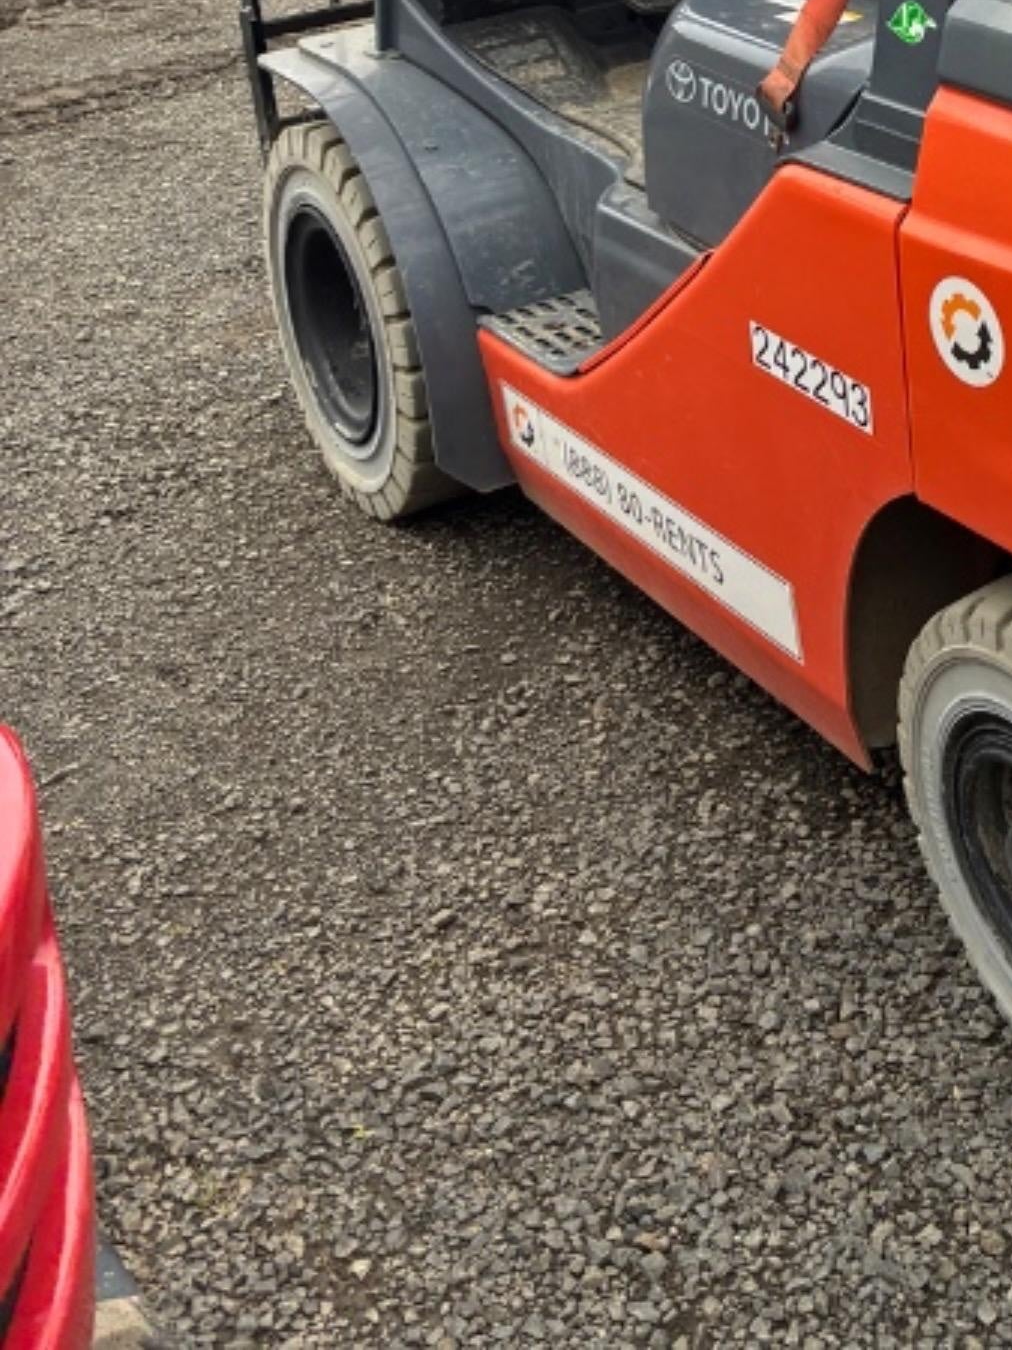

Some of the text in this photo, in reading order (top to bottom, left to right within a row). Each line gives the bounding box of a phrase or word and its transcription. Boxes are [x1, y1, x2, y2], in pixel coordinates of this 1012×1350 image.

[698, 75, 789, 147] TOYO
[753, 326, 870, 428] 242293
[617, 482, 724, 586] 80-RENTS
